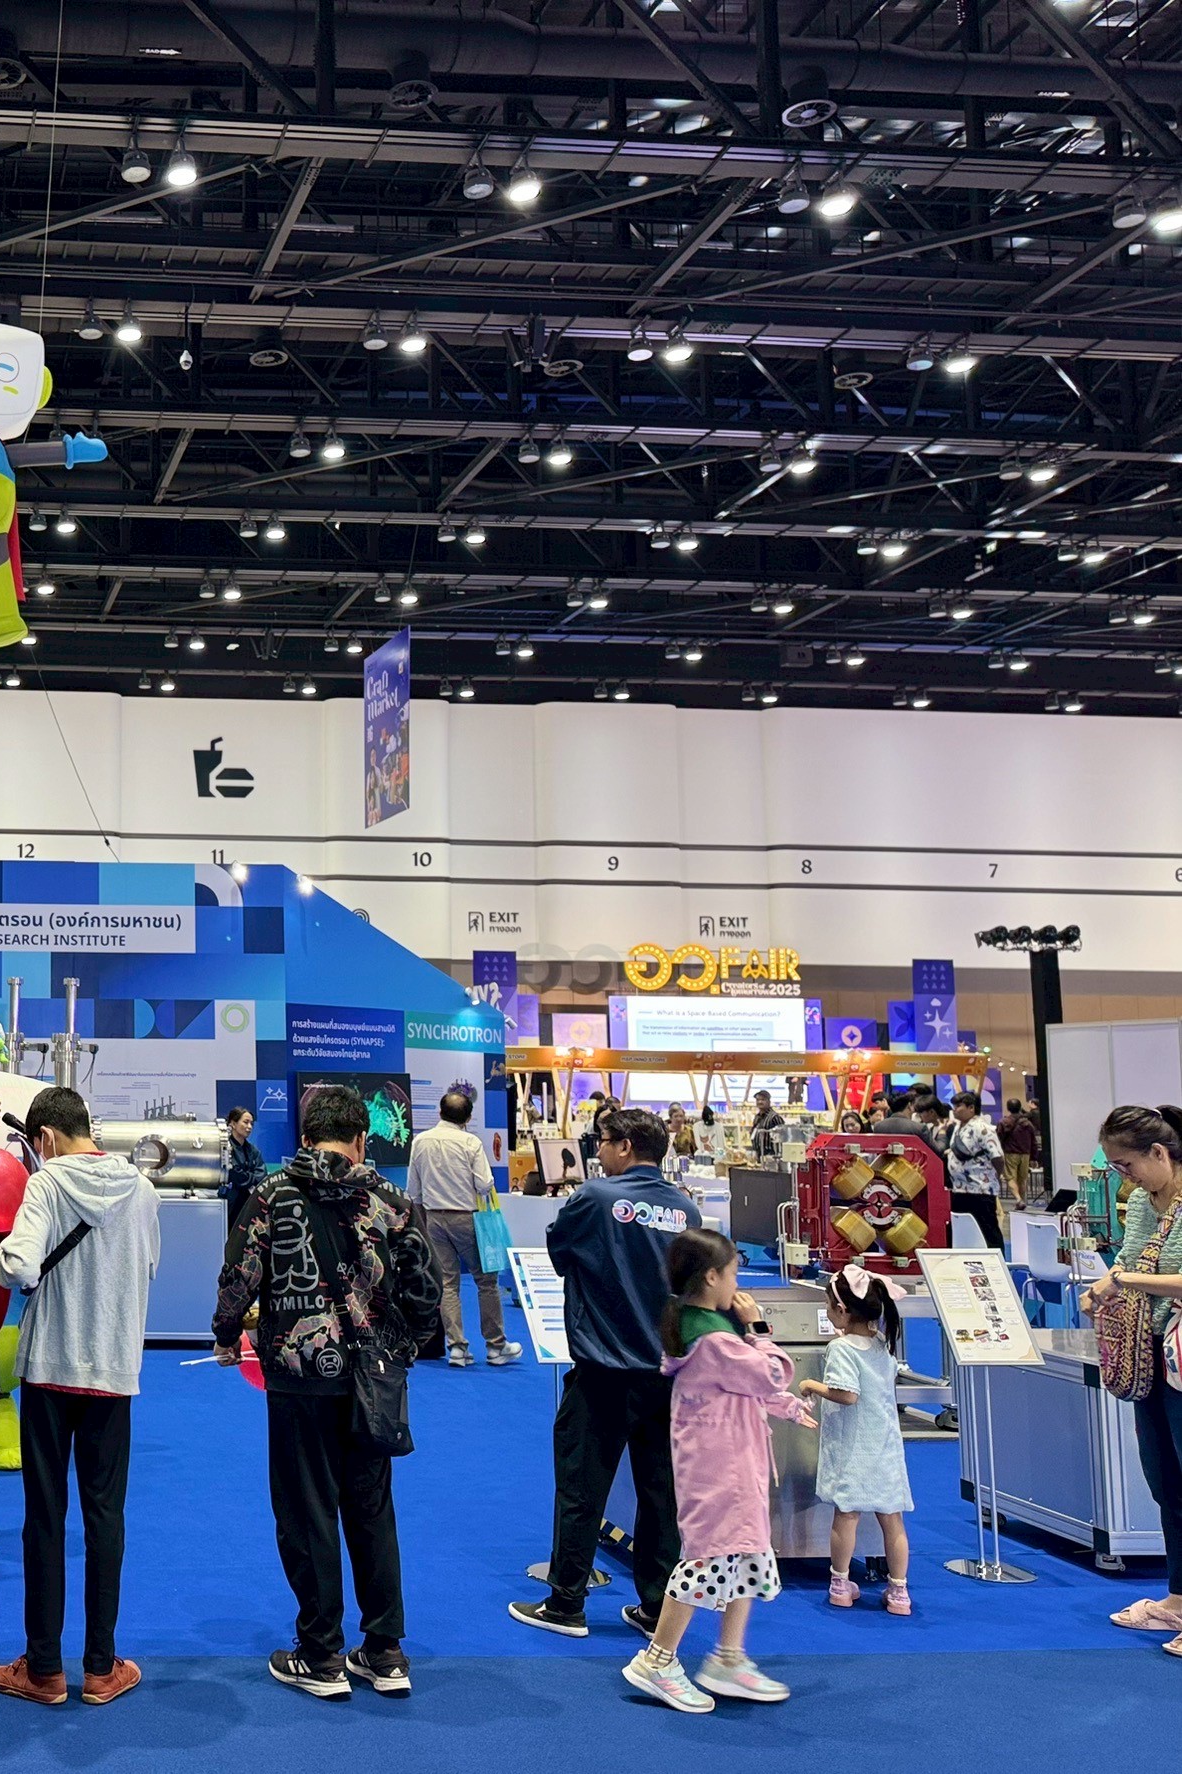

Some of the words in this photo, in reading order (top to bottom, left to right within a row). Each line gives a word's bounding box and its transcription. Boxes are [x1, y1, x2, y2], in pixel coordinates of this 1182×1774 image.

[17, 844, 35, 858] 12
[211, 849, 225, 864] 11
[412, 852, 432, 867] 10
[607, 856, 619, 871] 9
[801, 859, 813, 874] 8
[988, 863, 999, 878] 7
[49, 911, 182, 932] (องค์การมหาชน)
[489, 912, 520, 924] EXIT
[719, 916, 749, 928] EXIT
[53, 934, 126, 947] INSTITUTE
[769, 983, 801, 996] 2025
[406, 1021, 502, 1045] SYNCHROTRON
[257, 1172, 290, 1194] BYMIL
